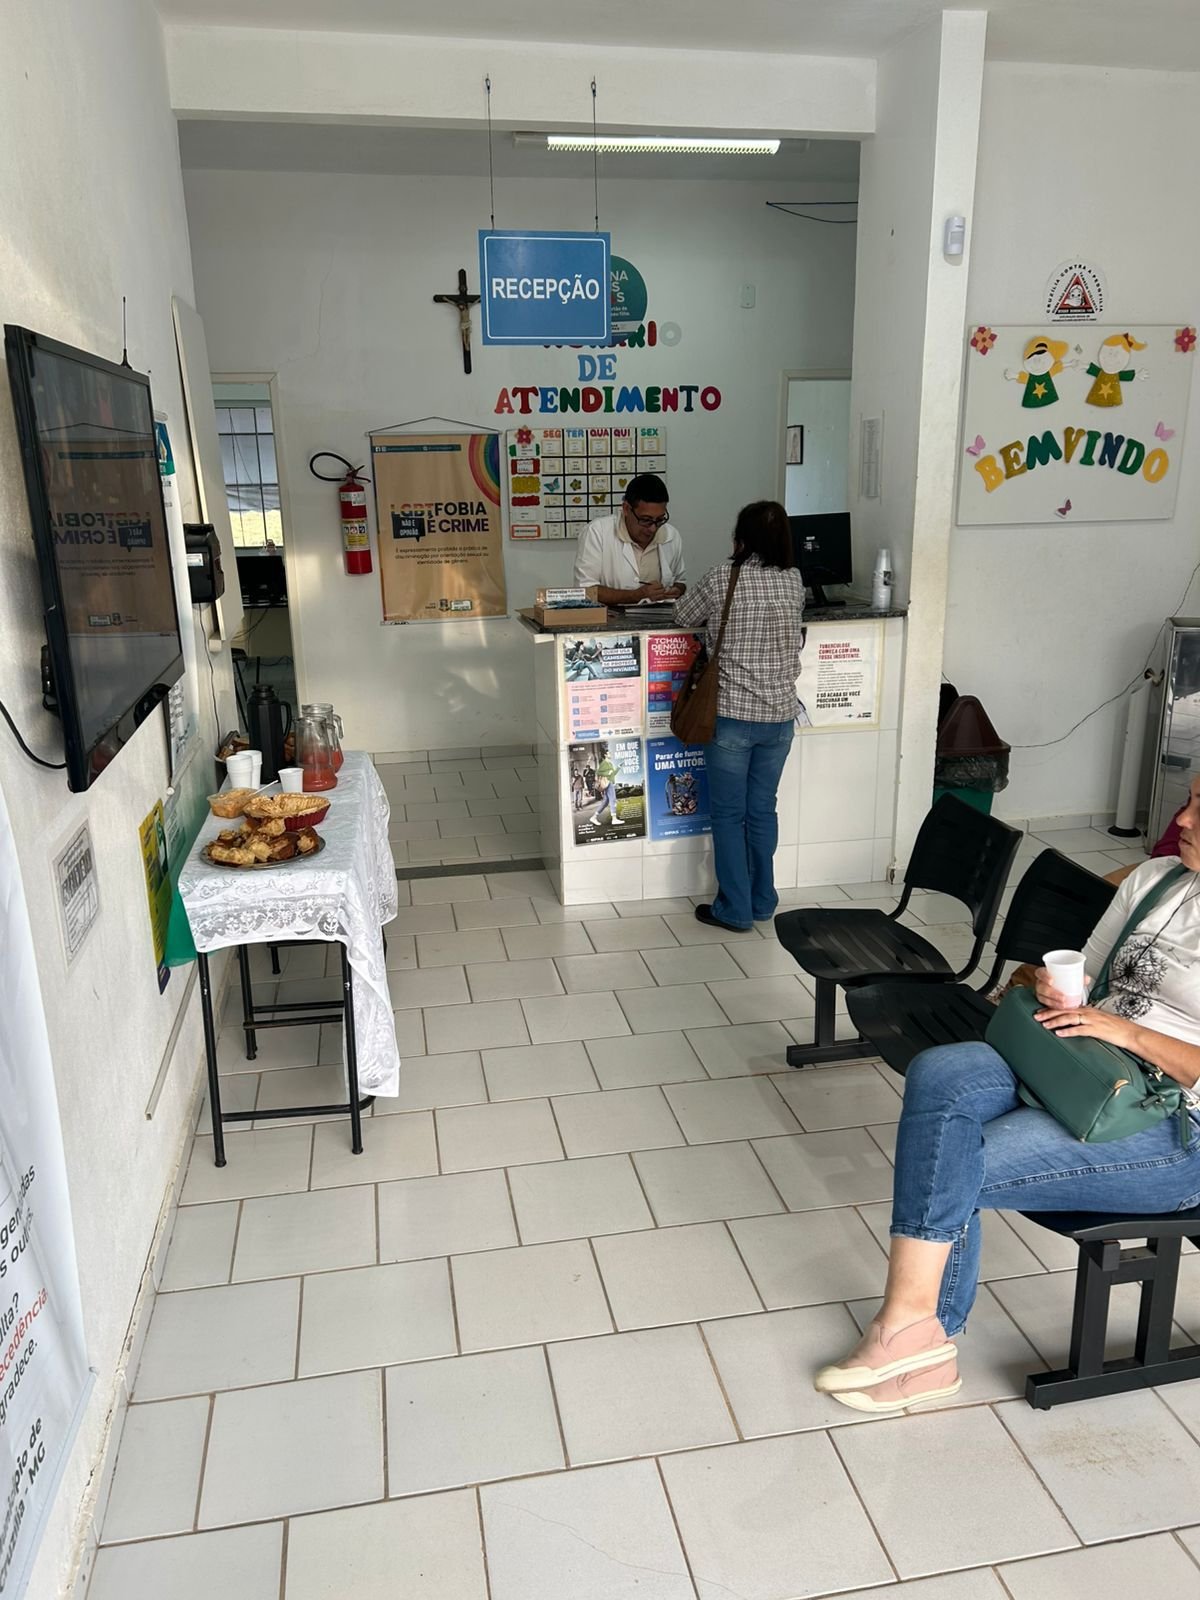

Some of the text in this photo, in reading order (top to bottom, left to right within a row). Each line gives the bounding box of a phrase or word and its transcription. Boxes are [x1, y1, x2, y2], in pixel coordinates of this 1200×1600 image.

[492, 274, 600, 304] RECEPÇÃO
[578, 353, 617, 382] DE
[494, 385, 722, 414] ATENDIMENTO
[543, 428, 659, 438] SEG TER QUA QUI SEX
[390, 502, 487, 517] LGBTFOBIA
[402, 518, 411, 526] NÃO
[427, 514, 490, 532] É CRIME
[616, 742, 639, 752] EM QUE
[624, 766, 640, 774] VIVE?
[654, 756, 706, 770] UMA VITÓRI
[30, 1418, 42, 1449] de
[28, 1441, 46, 1485] MG
